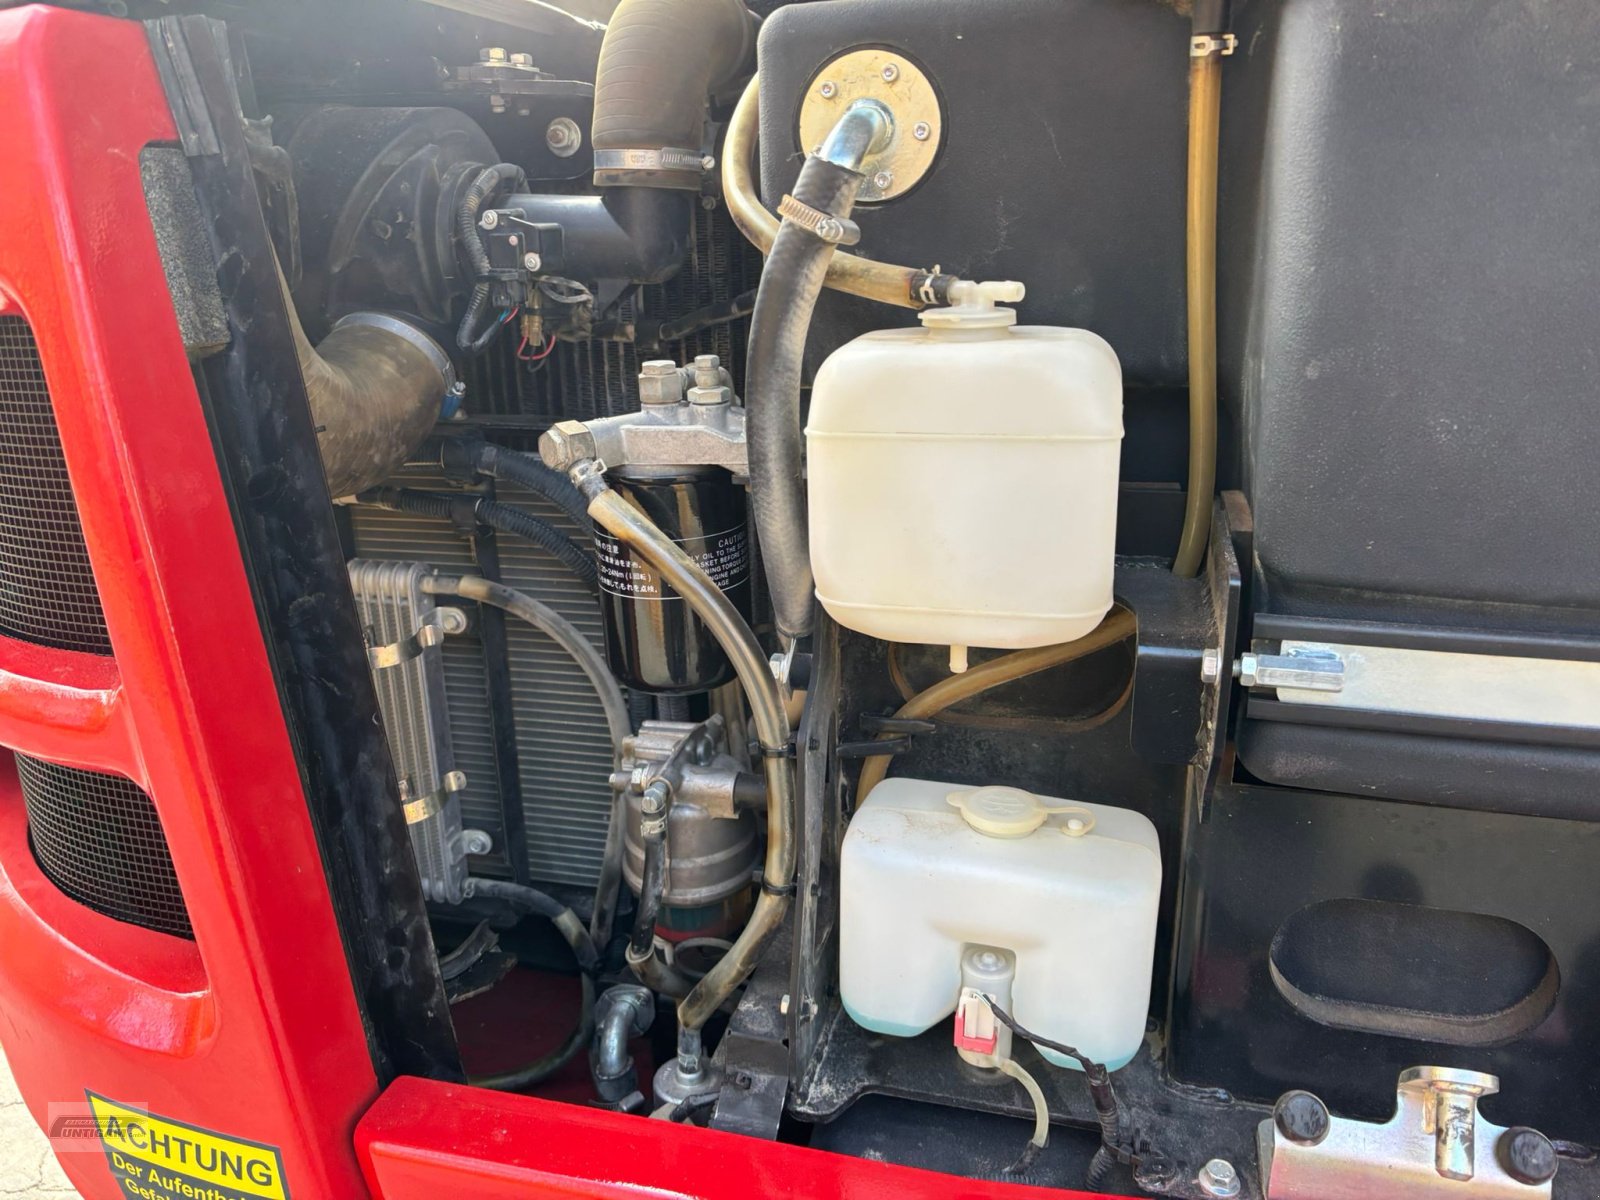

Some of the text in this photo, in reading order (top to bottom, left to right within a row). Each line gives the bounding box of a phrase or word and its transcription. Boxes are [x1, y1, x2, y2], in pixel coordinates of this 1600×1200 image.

[716, 549, 725, 557] TO
[107, 1115, 273, 1187] ACHTUNG
[112, 1151, 143, 1178] Der
